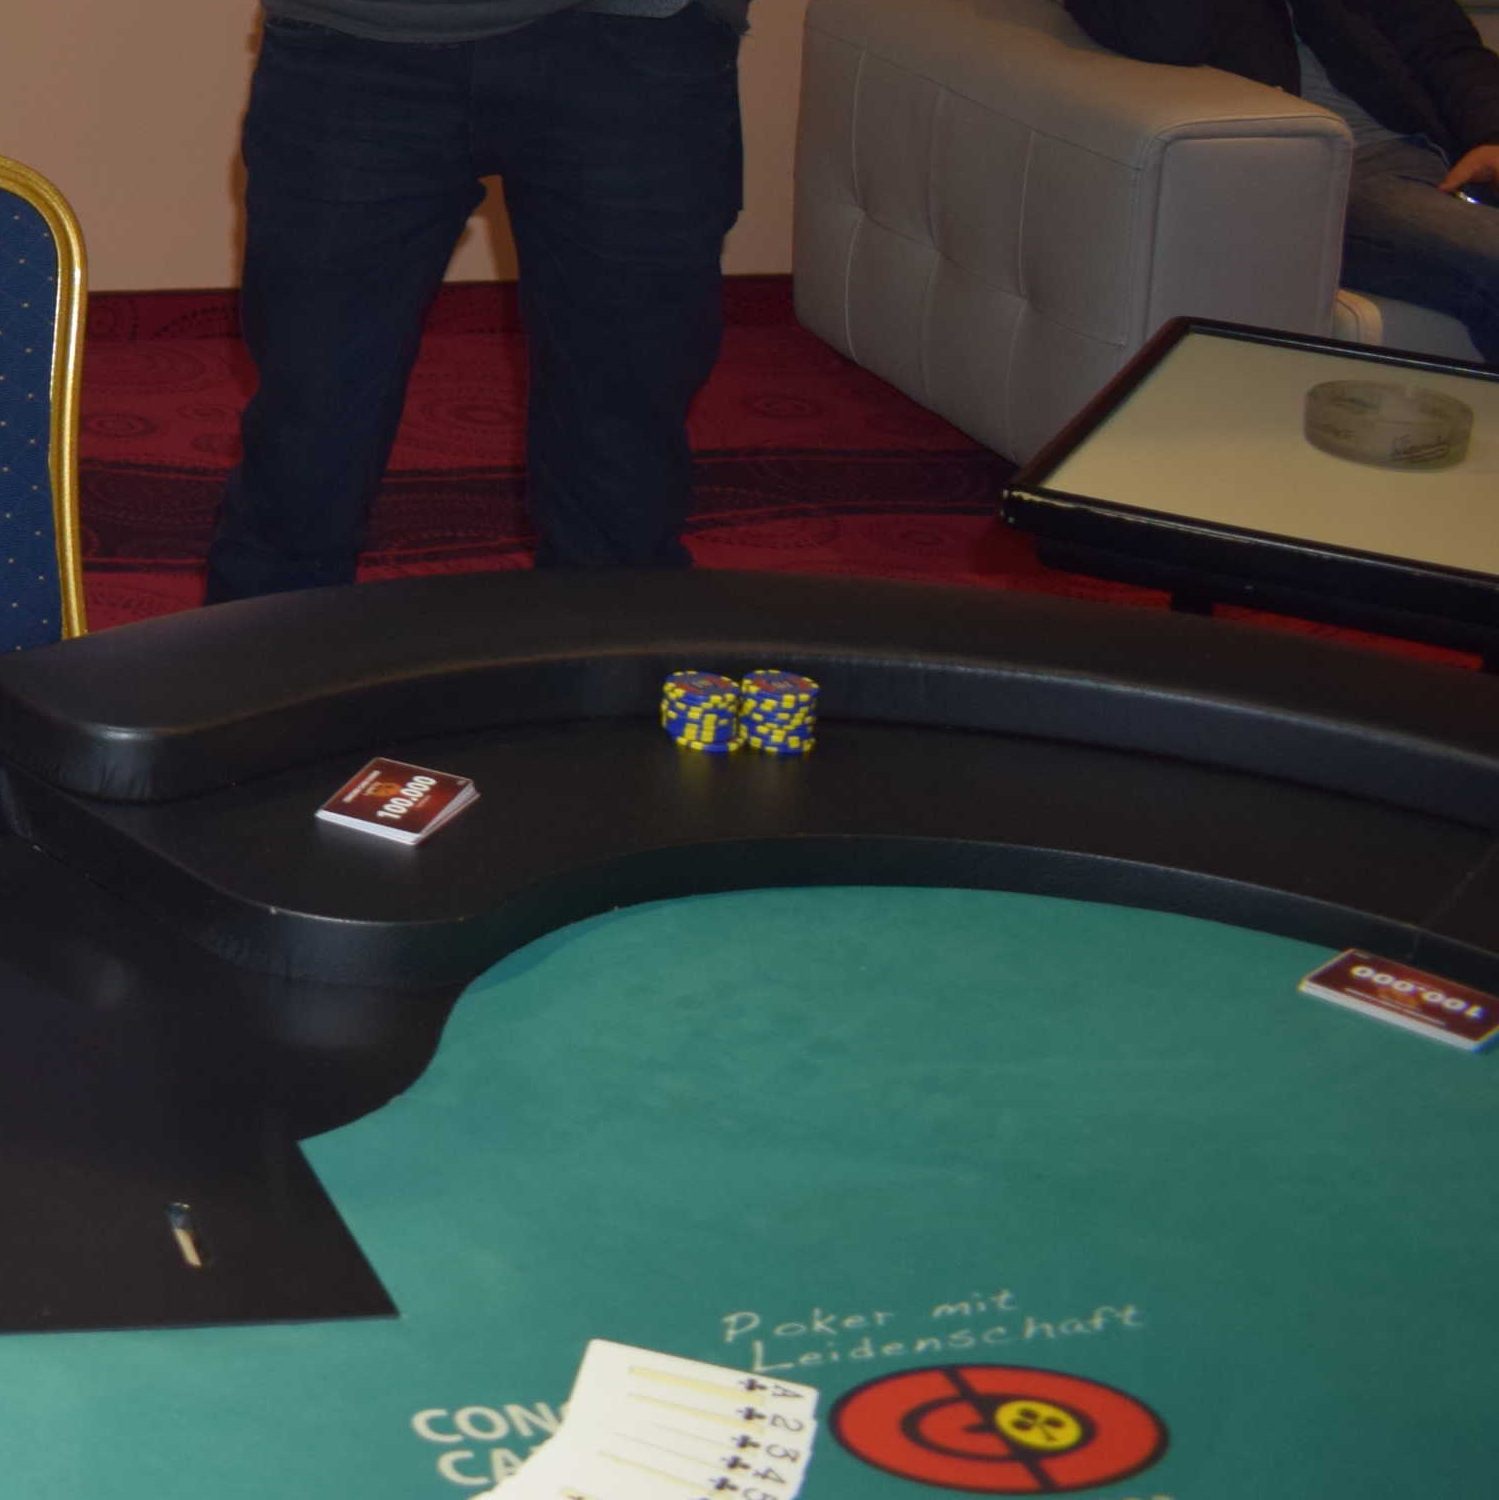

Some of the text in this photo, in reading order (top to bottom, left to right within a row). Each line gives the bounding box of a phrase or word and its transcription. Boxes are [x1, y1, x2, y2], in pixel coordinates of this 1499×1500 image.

[376, 775, 438, 820] 100.000
[722, 1288, 1020, 1344] Poker mit
[752, 1303, 1144, 1373] Leidenschaft
[771, 1384, 804, 1399] A
[411, 1402, 569, 1443] CON
[770, 1413, 804, 1433] 2
[766, 1443, 800, 1463] 3
[753, 1467, 787, 1485] 4
